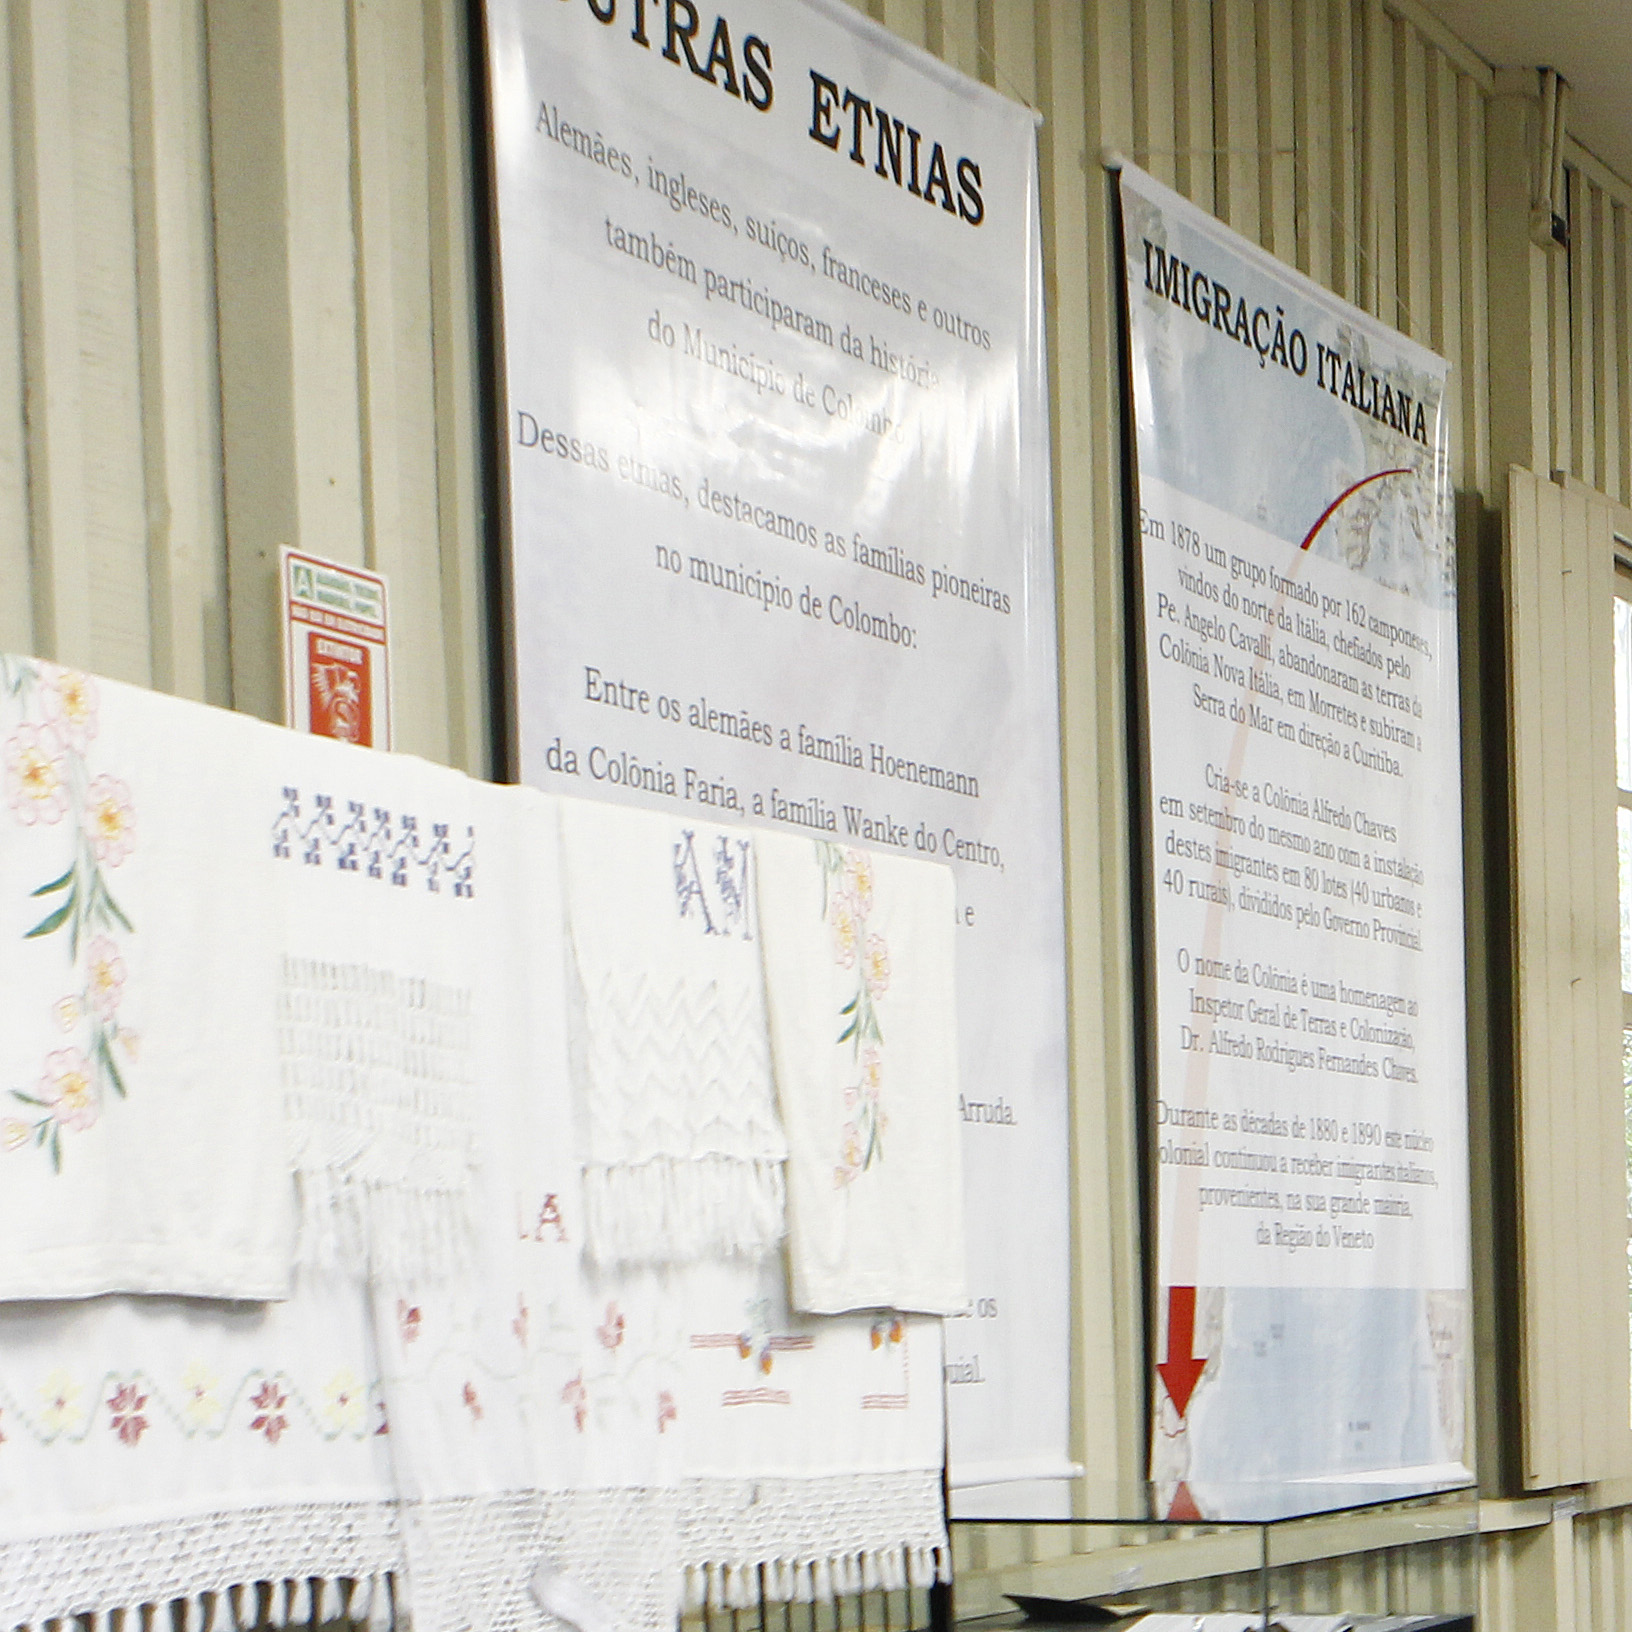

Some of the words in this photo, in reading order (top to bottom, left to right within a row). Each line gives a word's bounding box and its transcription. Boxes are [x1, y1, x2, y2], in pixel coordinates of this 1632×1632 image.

[808, 68, 986, 227] ETNIAS
[535, 99, 640, 186] Alemães,
[647, 155, 738, 236] ingleses,
[745, 215, 816, 275] suíços,
[821, 244, 912, 315] franceses
[916, 299, 927, 322] e
[932, 306, 991, 351] outros
[1143, 239, 1307, 377] IMIGRAÇÃO
[1317, 342, 1428, 446] ITALIANA
[654, 543, 682, 574] no
[687, 555, 793, 612] município
[798, 584, 822, 620] de
[827, 593, 917, 649] Colombo:
[544, 736, 580, 776] da
[587, 745, 677, 797] Colônia
[682, 766, 745, 817] Faria,
[751, 792, 765, 816] a
[769, 786, 839, 832] família
[841, 804, 909, 848] Wanke
[913, 820, 937, 854] do
[941, 827, 1004, 873] Centro,
[583, 665, 650, 715] Entre
[656, 694, 682, 723] os
[687, 696, 773, 747] alemães
[778, 727, 792, 752] a
[797, 722, 865, 770] família
[868, 742, 980, 798] Hoenemann
